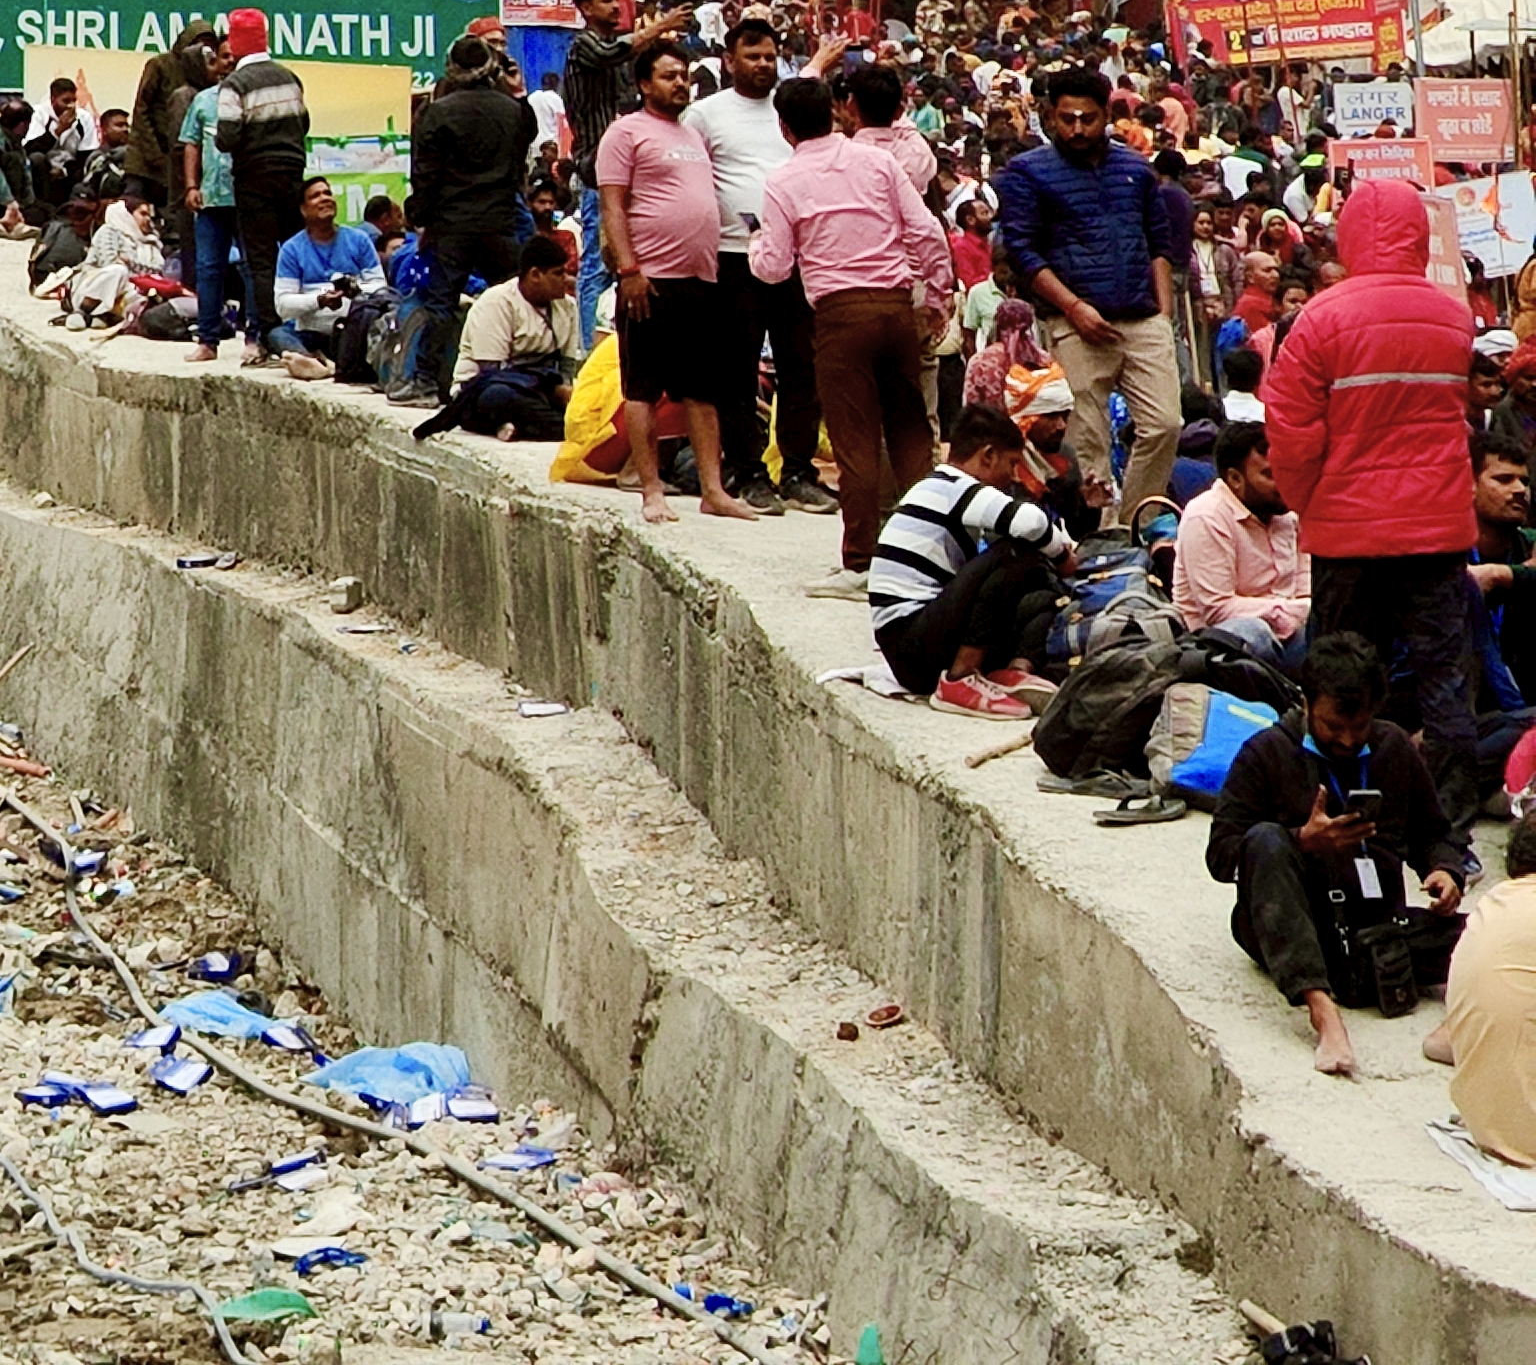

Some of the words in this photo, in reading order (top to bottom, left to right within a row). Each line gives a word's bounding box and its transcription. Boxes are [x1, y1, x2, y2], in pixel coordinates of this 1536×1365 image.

[15, 9, 120, 51] SHRI
[400, 13, 436, 58] JI
[1341, 106, 1406, 121] LANGER
